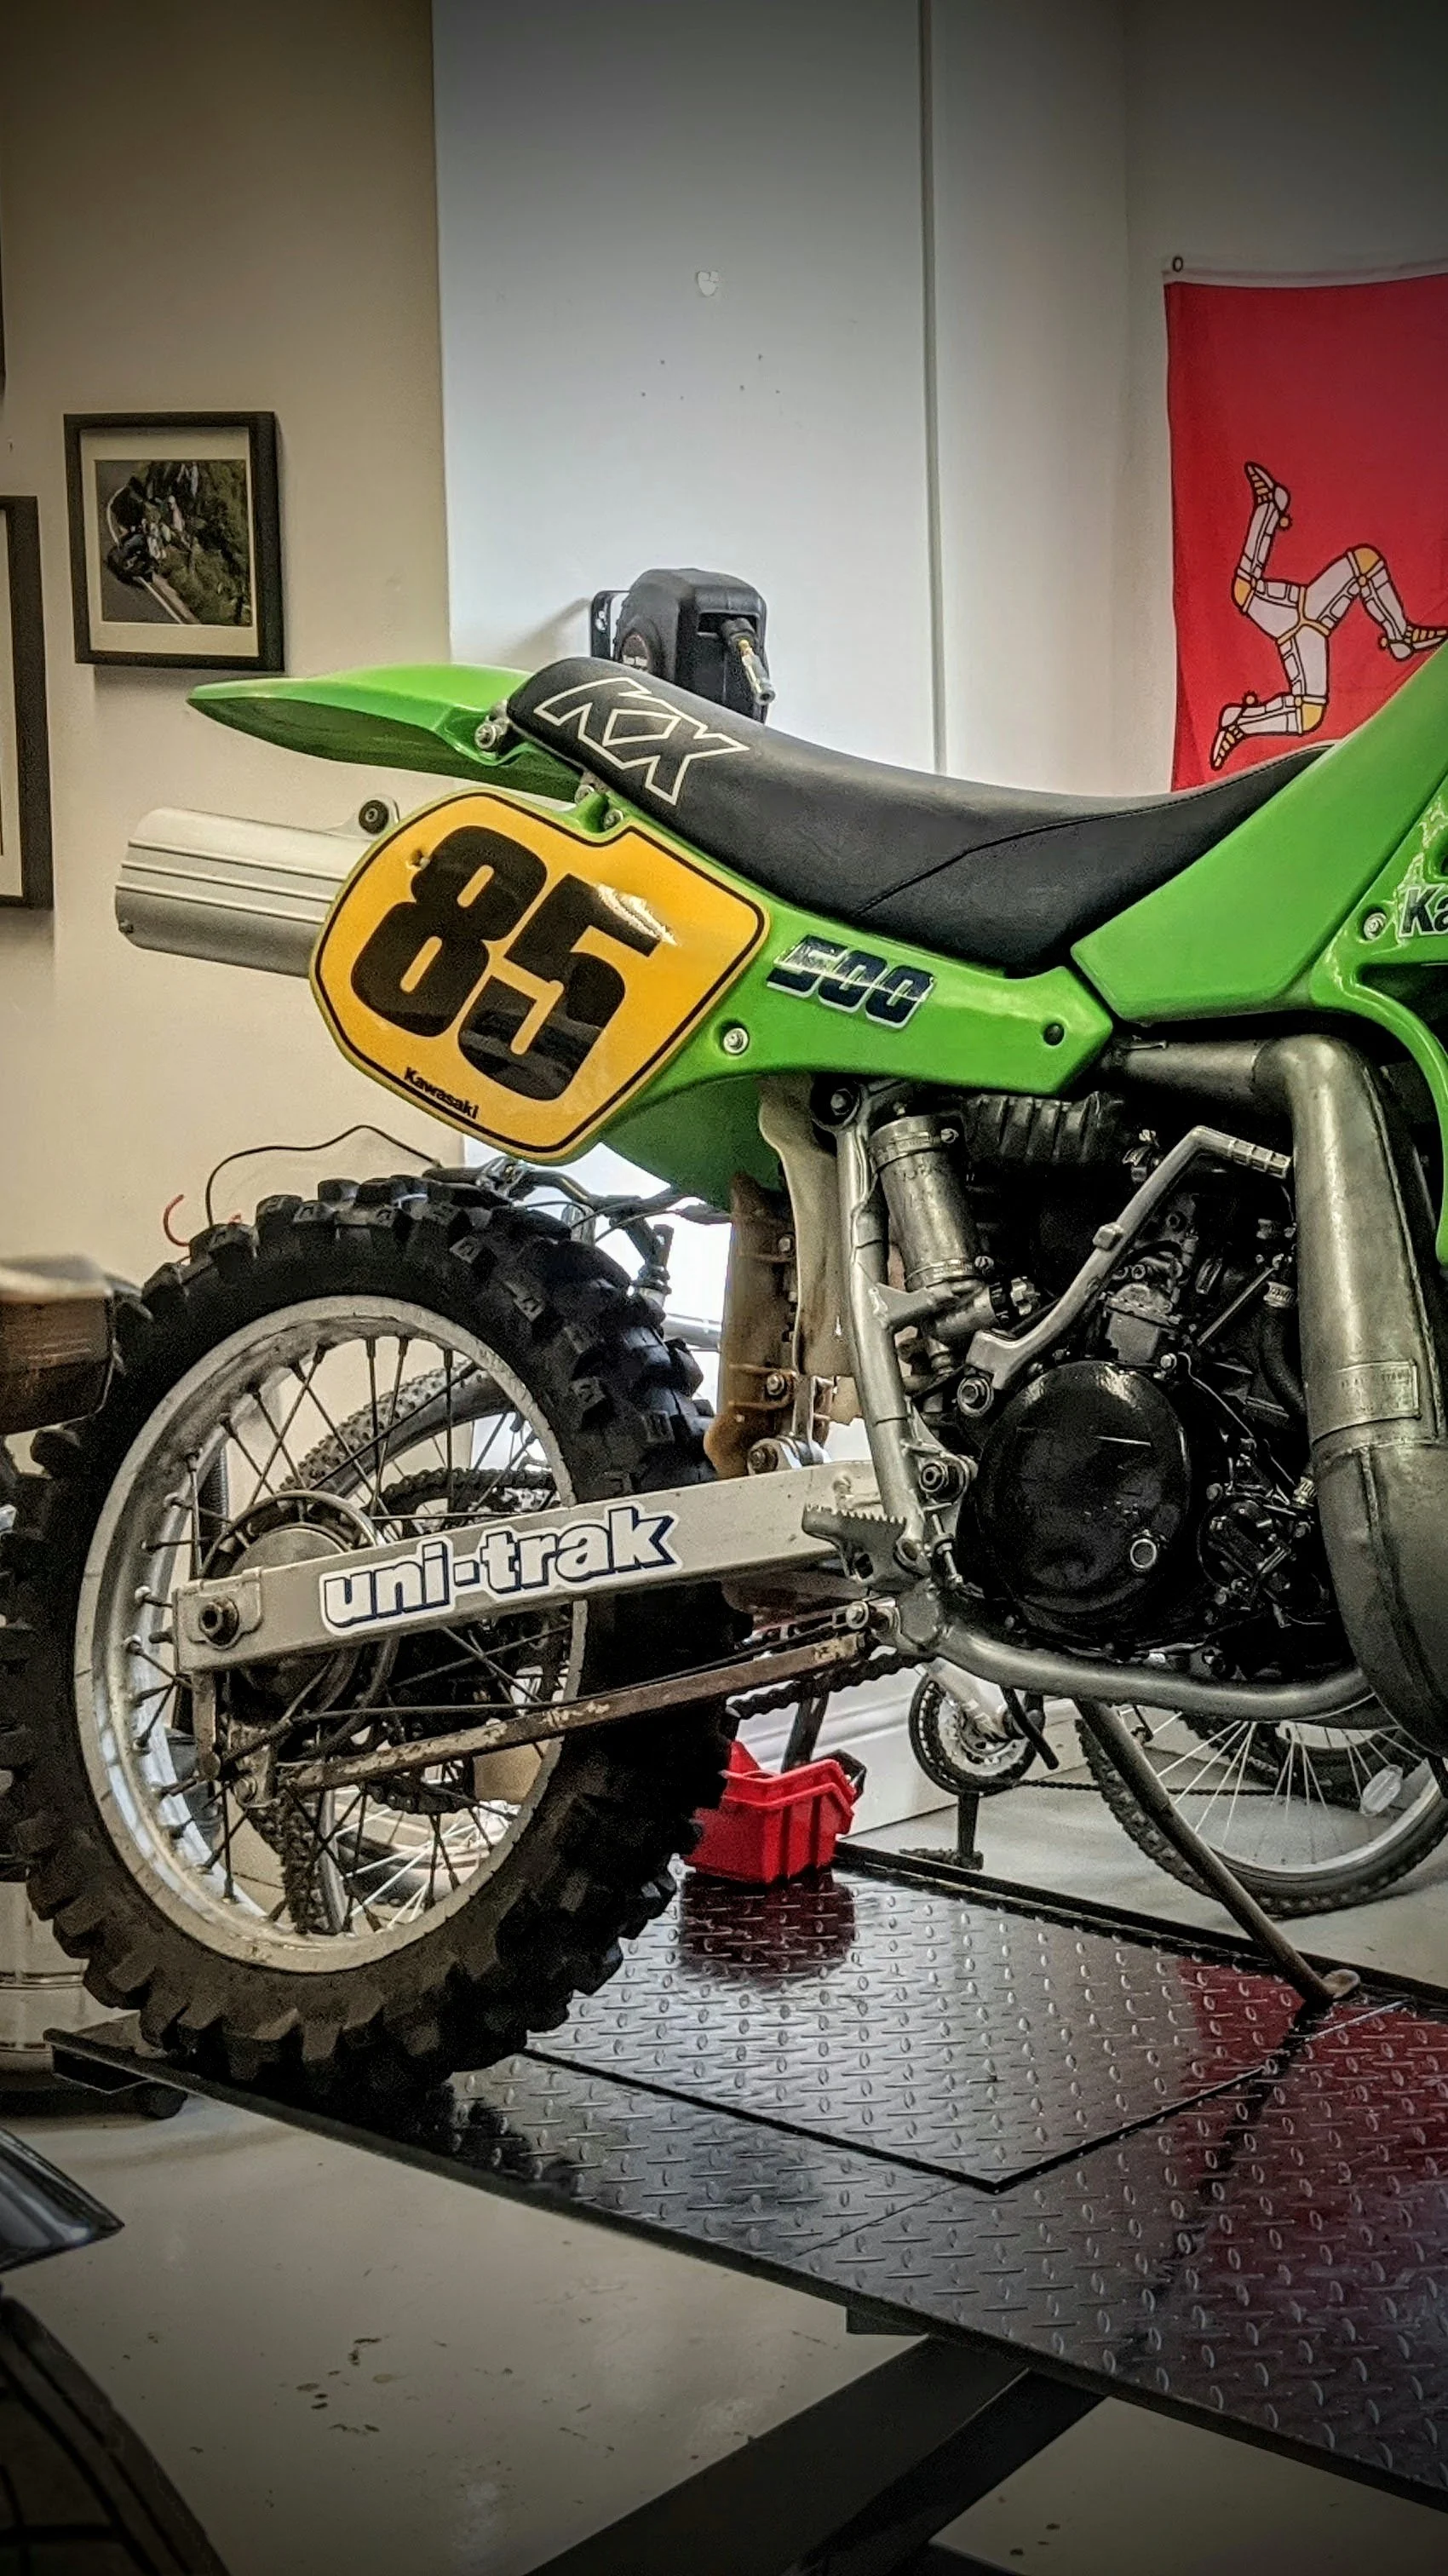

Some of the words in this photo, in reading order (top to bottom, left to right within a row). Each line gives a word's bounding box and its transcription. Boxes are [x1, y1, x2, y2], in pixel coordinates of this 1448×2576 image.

[351, 825, 661, 1100] 85
[766, 934, 936, 1029] 500
[404, 1067, 479, 1119] Kawasaki
[323, 1506, 678, 1629] uni-trak
